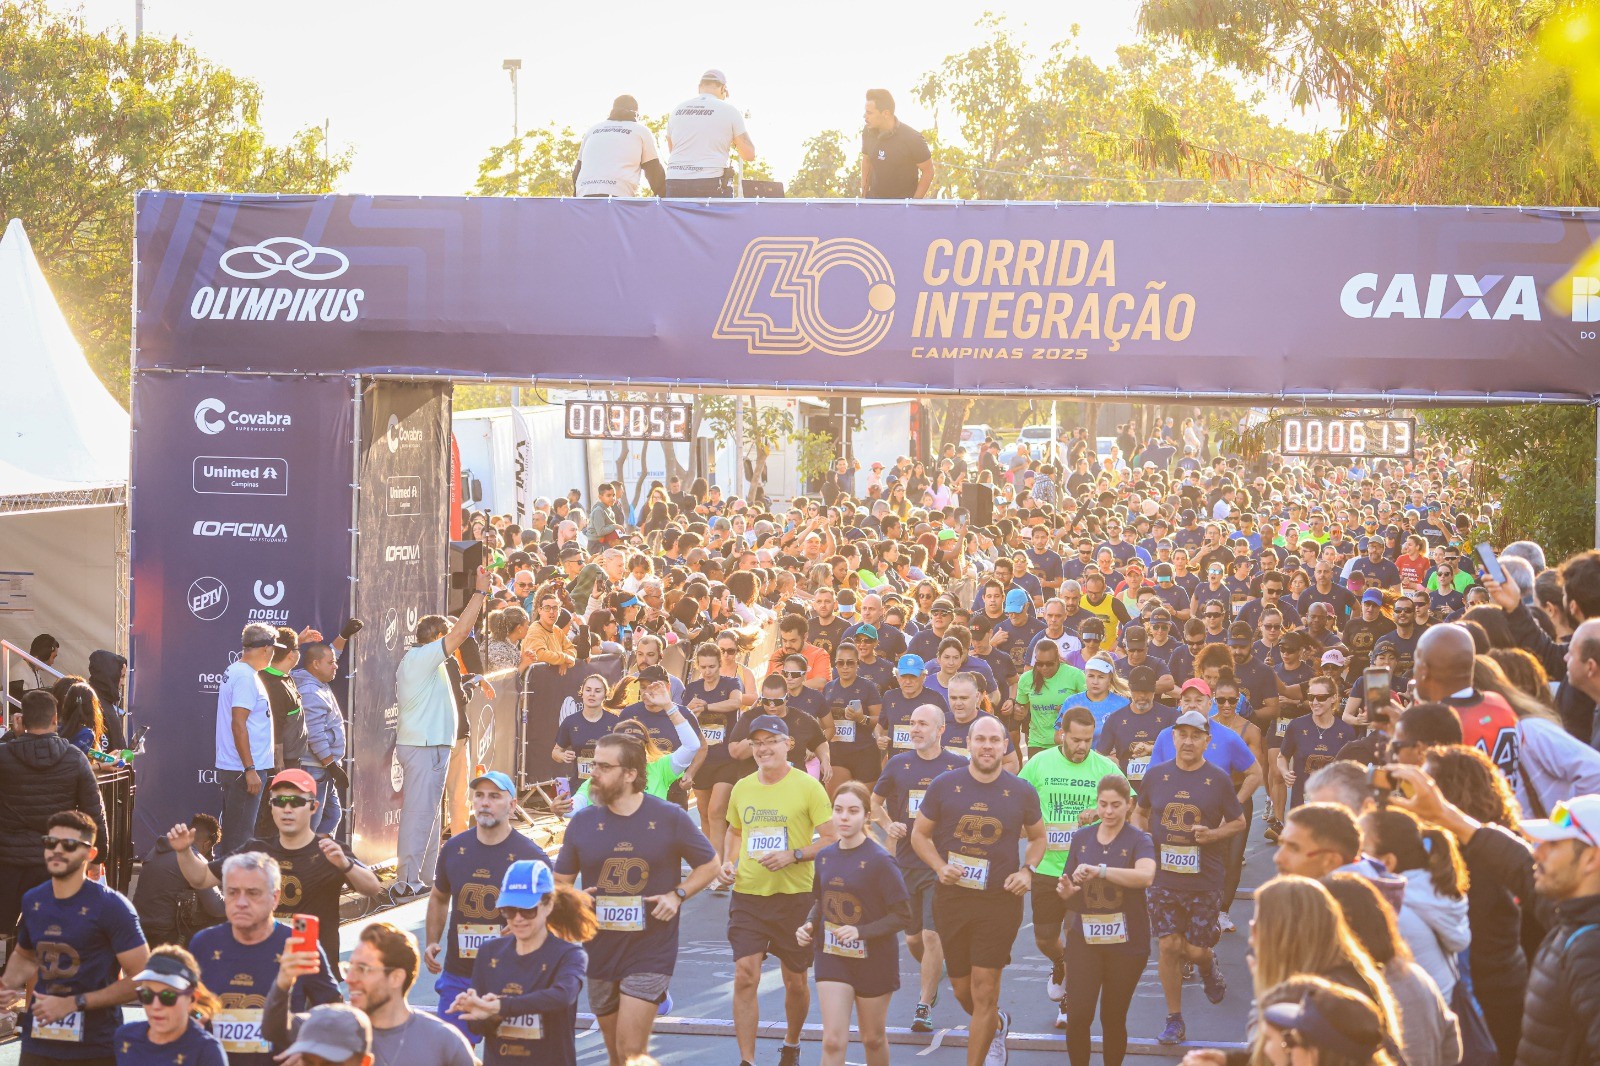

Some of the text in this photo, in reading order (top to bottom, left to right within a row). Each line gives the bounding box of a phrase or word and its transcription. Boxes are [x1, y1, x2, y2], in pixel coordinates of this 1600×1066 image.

[923, 238, 1116, 288] CORRIDA
[190, 286, 365, 322] OLYMPIKUS
[1339, 272, 1542, 322] CAIXA
[910, 280, 1197, 352] INTEGRAÇÃO
[911, 346, 1088, 360] CAMPINAS 2025
[228, 410, 292, 426] Covabra
[400, 427, 422, 441] Covabra
[203, 466, 259, 478] Unimed
[390, 486, 411, 498] Unimed
[200, 520, 288, 538] OFICINA
[193, 585, 222, 612] EPTV
[701, 729, 722, 740] 3719
[896, 732, 910, 742] 130
[1132, 764, 1149, 774] 107
[1070, 778, 1096, 788] 2025
[752, 836, 782, 850] 11902
[1165, 854, 1196, 866] 12030
[603, 908, 638, 921] 10261
[1090, 922, 1120, 936] 12197
